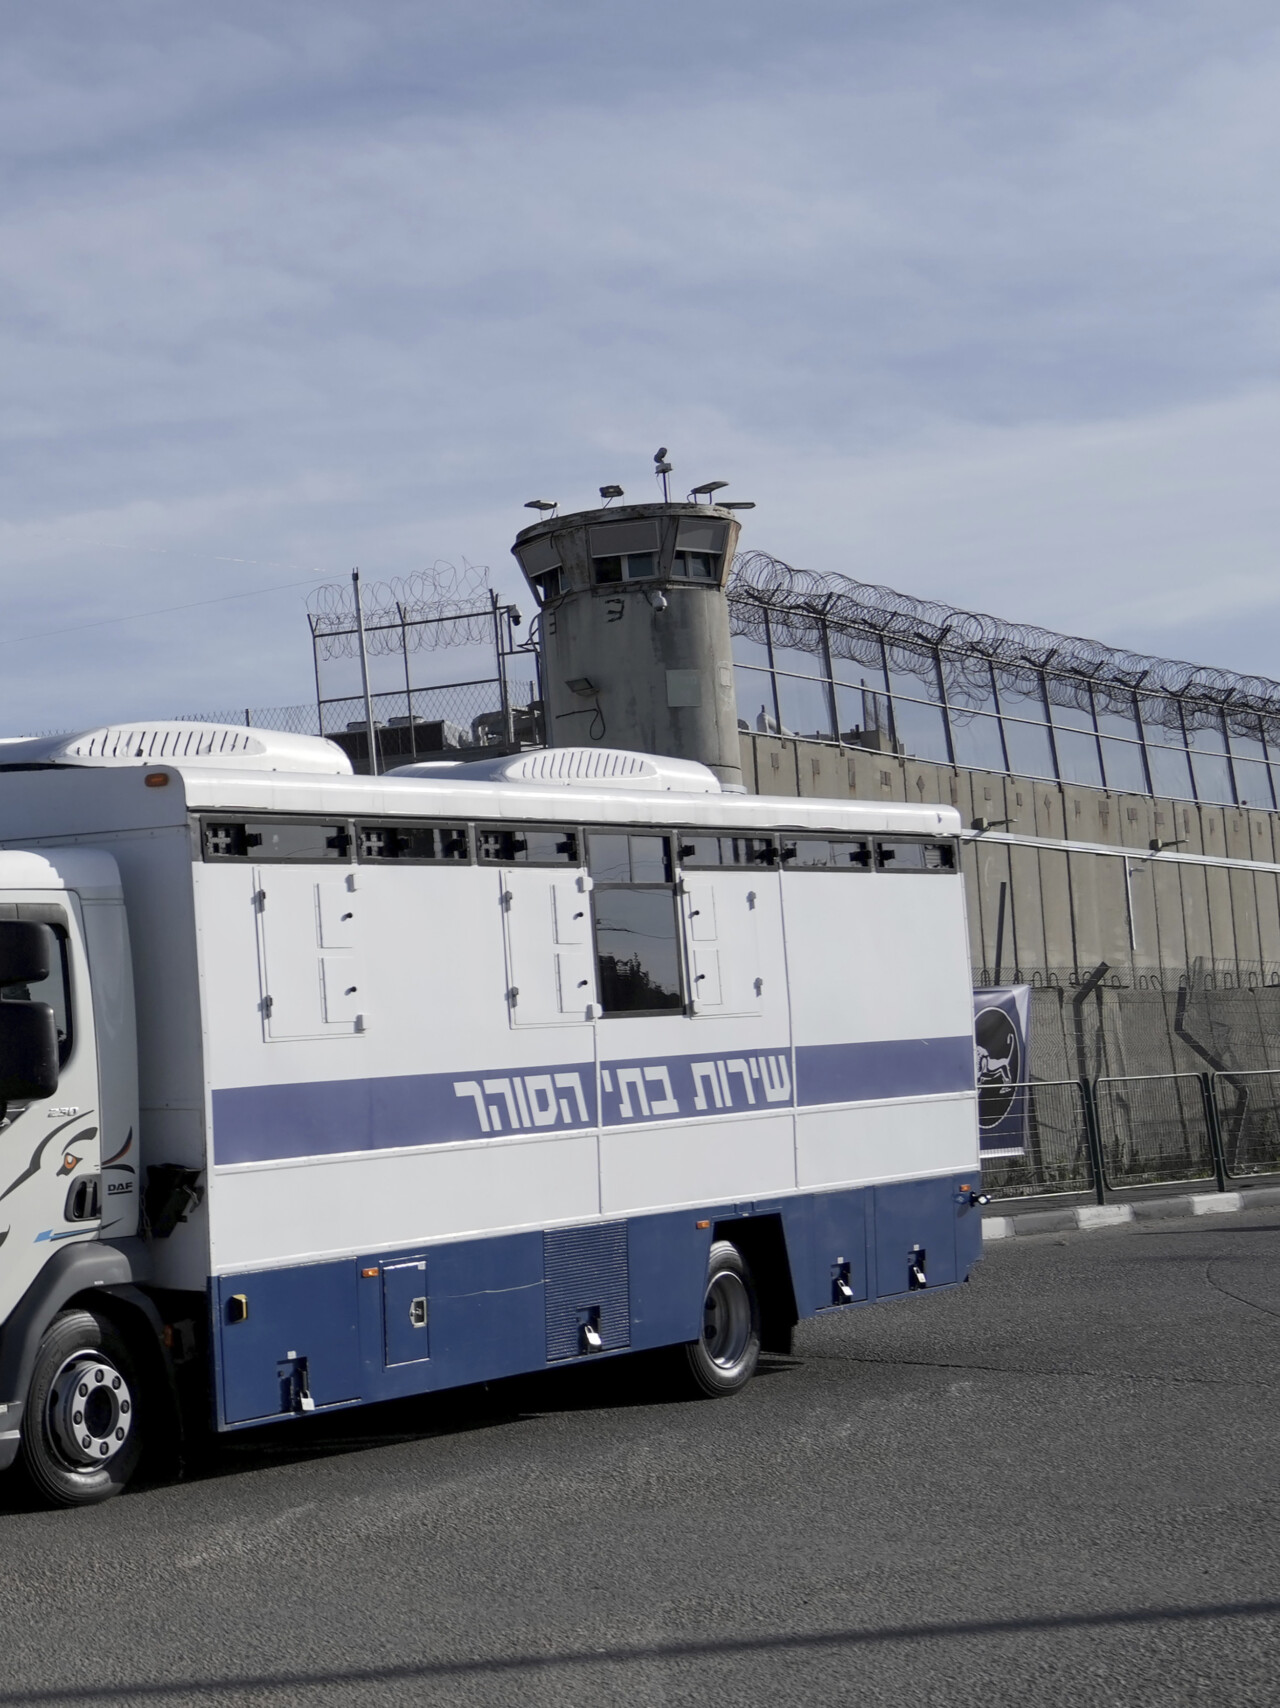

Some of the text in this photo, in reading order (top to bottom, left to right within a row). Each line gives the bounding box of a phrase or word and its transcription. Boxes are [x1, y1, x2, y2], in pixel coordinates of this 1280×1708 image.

[453, 1054, 791, 1133] שירות בתי הסוהר
[107, 1182, 133, 1192] DAF
